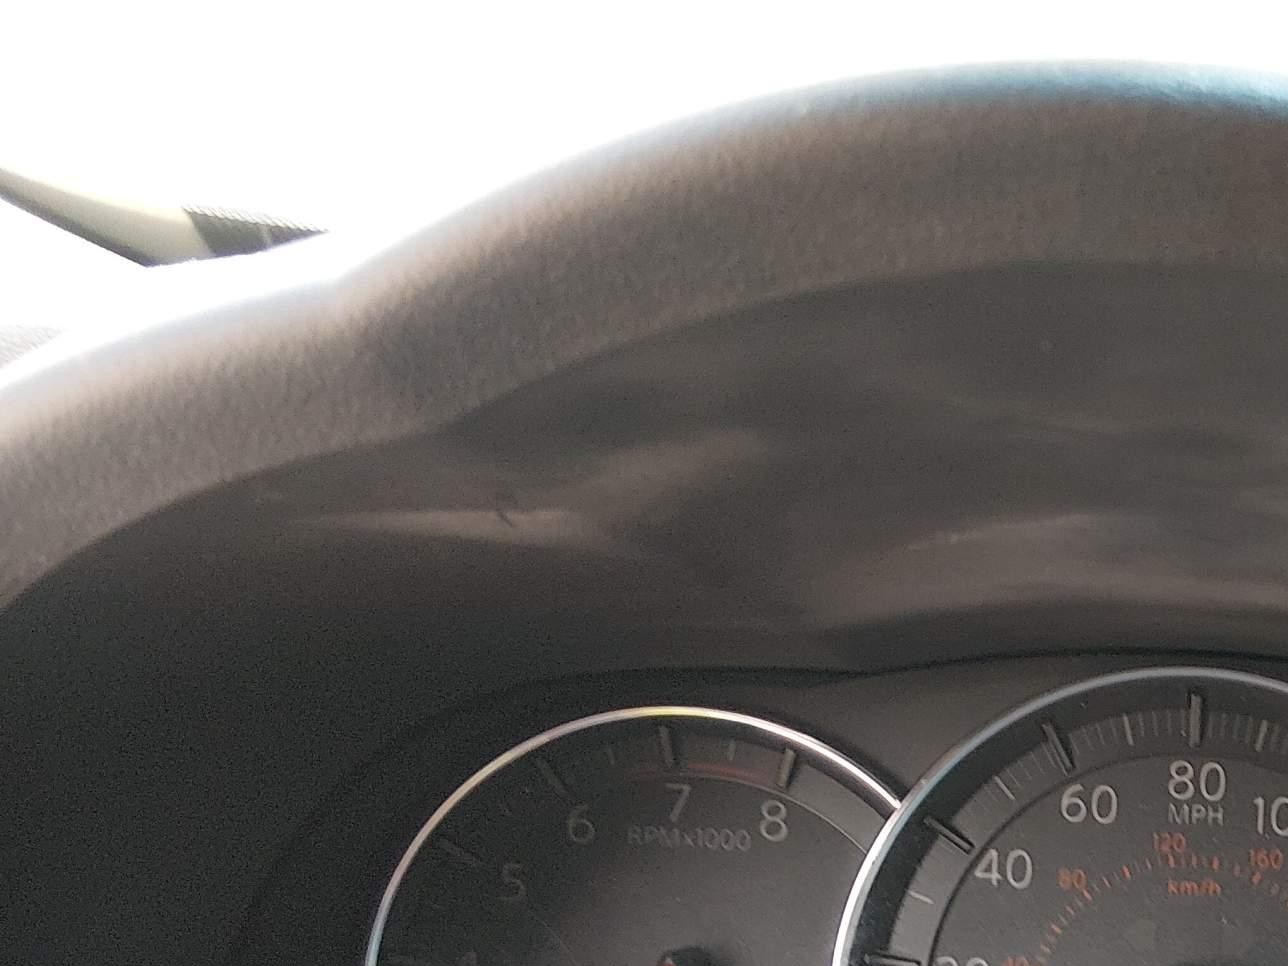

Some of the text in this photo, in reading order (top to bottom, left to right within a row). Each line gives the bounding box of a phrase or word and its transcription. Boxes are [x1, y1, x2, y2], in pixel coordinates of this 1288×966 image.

[1167, 761, 1226, 801] 80
[665, 784, 690, 822] 7
[759, 801, 788, 841] 8
[1060, 784, 1118, 825] 60
[1168, 803, 1224, 825] MPH
[567, 805, 595, 845] 6
[1153, 834, 1186, 854] 120
[974, 849, 1033, 889] 40
[1249, 849, 1283, 870] 160
[502, 863, 526, 902] 5
[1058, 868, 1086, 891] 80
[1167, 877, 1221, 898] km/h
